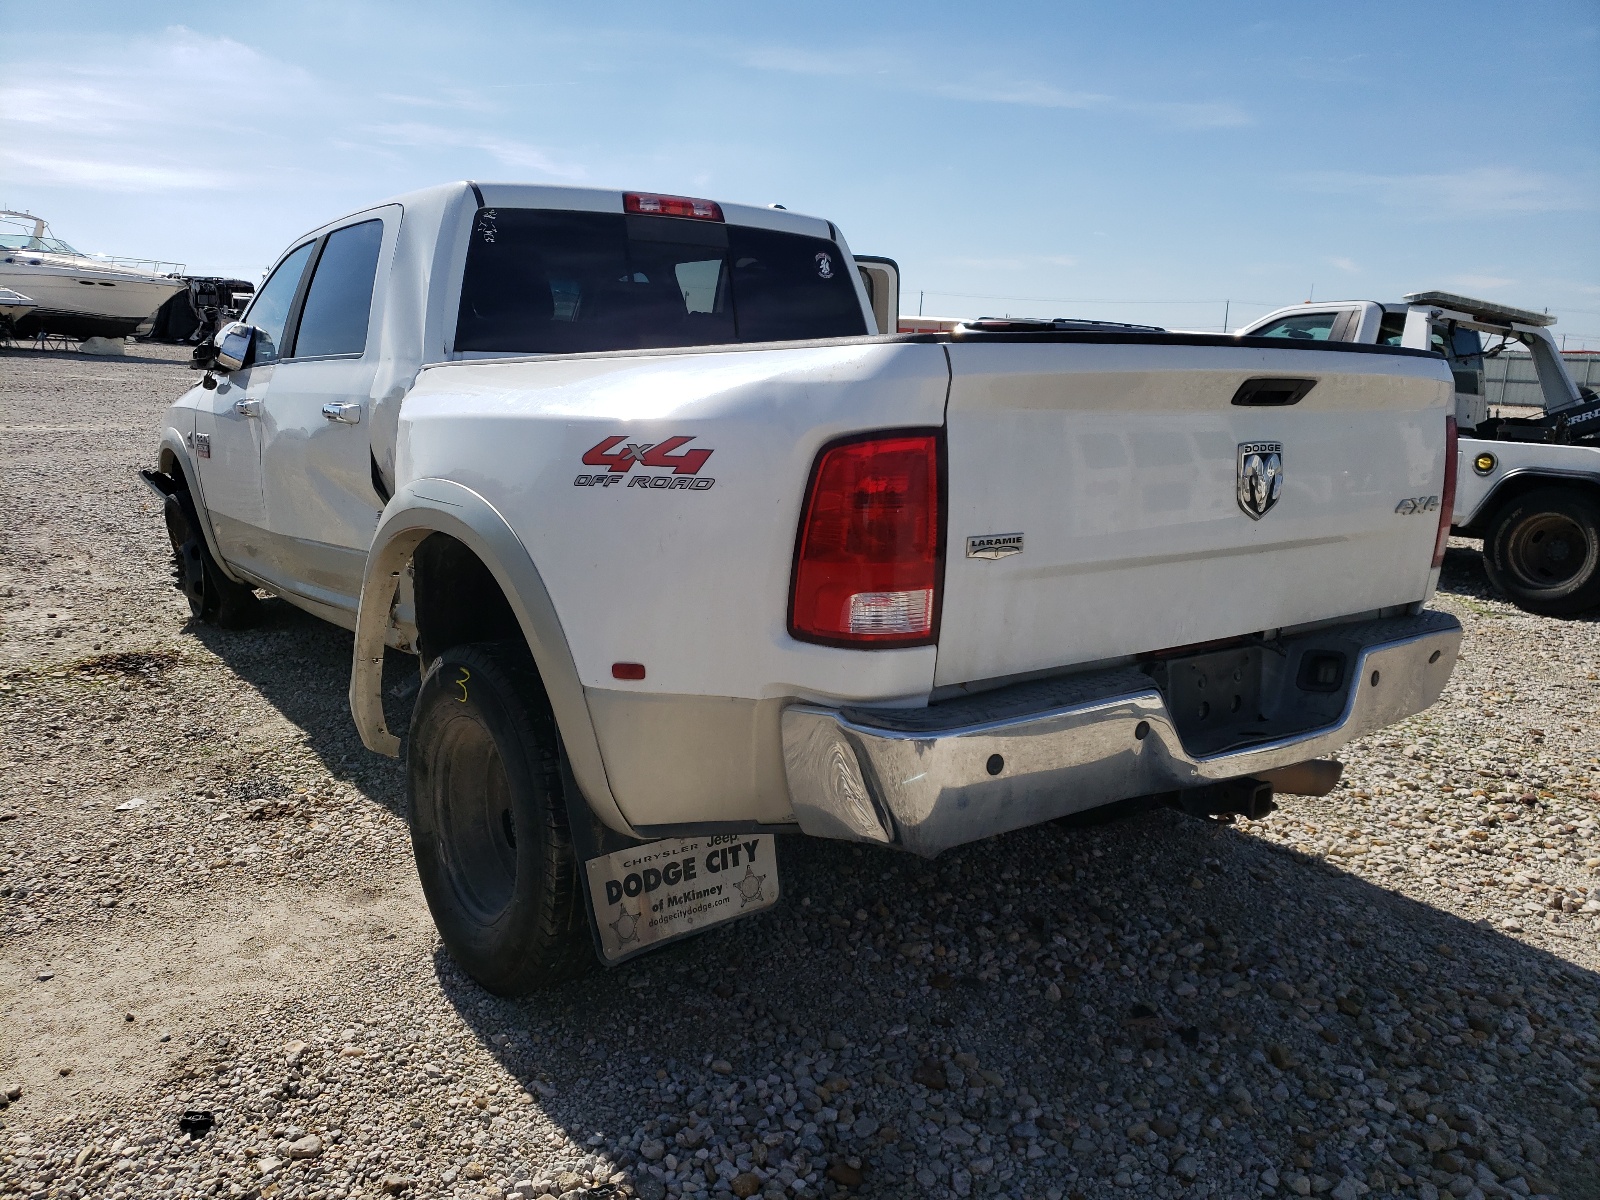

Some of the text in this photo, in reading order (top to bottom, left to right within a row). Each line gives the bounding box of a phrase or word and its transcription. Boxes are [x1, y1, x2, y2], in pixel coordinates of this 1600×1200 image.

[1245, 444, 1281, 453] DODGE
[574, 475, 716, 490] OFF ROAD
[971, 536, 1023, 547] LARAMIE
[454, 665, 471, 703] 3
[623, 834, 738, 868] CHRYSLER Jeep
[606, 839, 760, 906] DODGE CITY
[648, 895, 731, 928] dodgecitydodge.com
[651, 884, 723, 914] of McKinney
